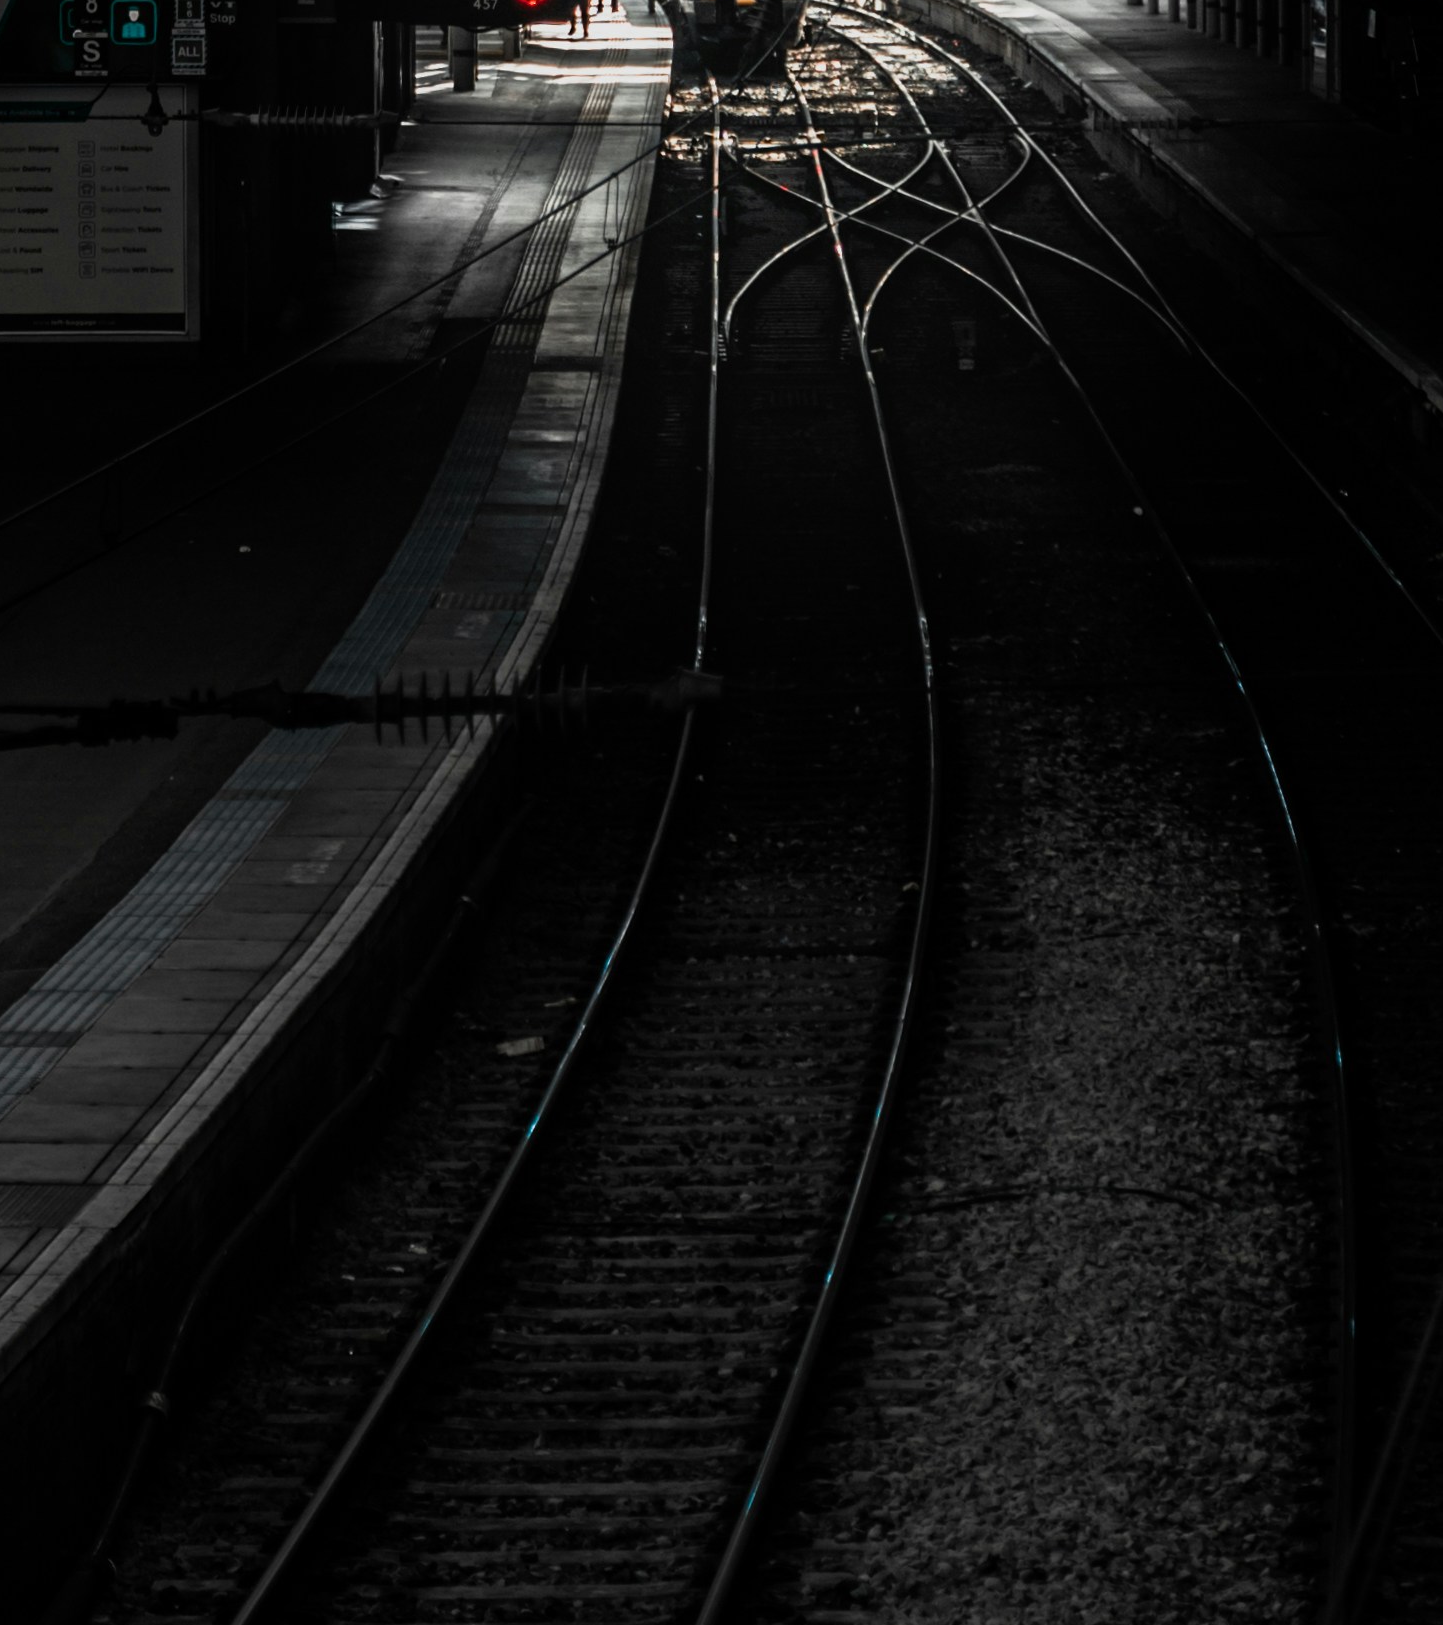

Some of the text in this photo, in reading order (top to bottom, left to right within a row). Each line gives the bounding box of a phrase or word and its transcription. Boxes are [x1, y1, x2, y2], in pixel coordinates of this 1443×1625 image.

[209, 12, 237, 27] Stop
[82, 39, 101, 63] S
[177, 45, 201, 58] ALL
[22, 164, 53, 175] Delivery
[17, 206, 49, 215] Luggage
